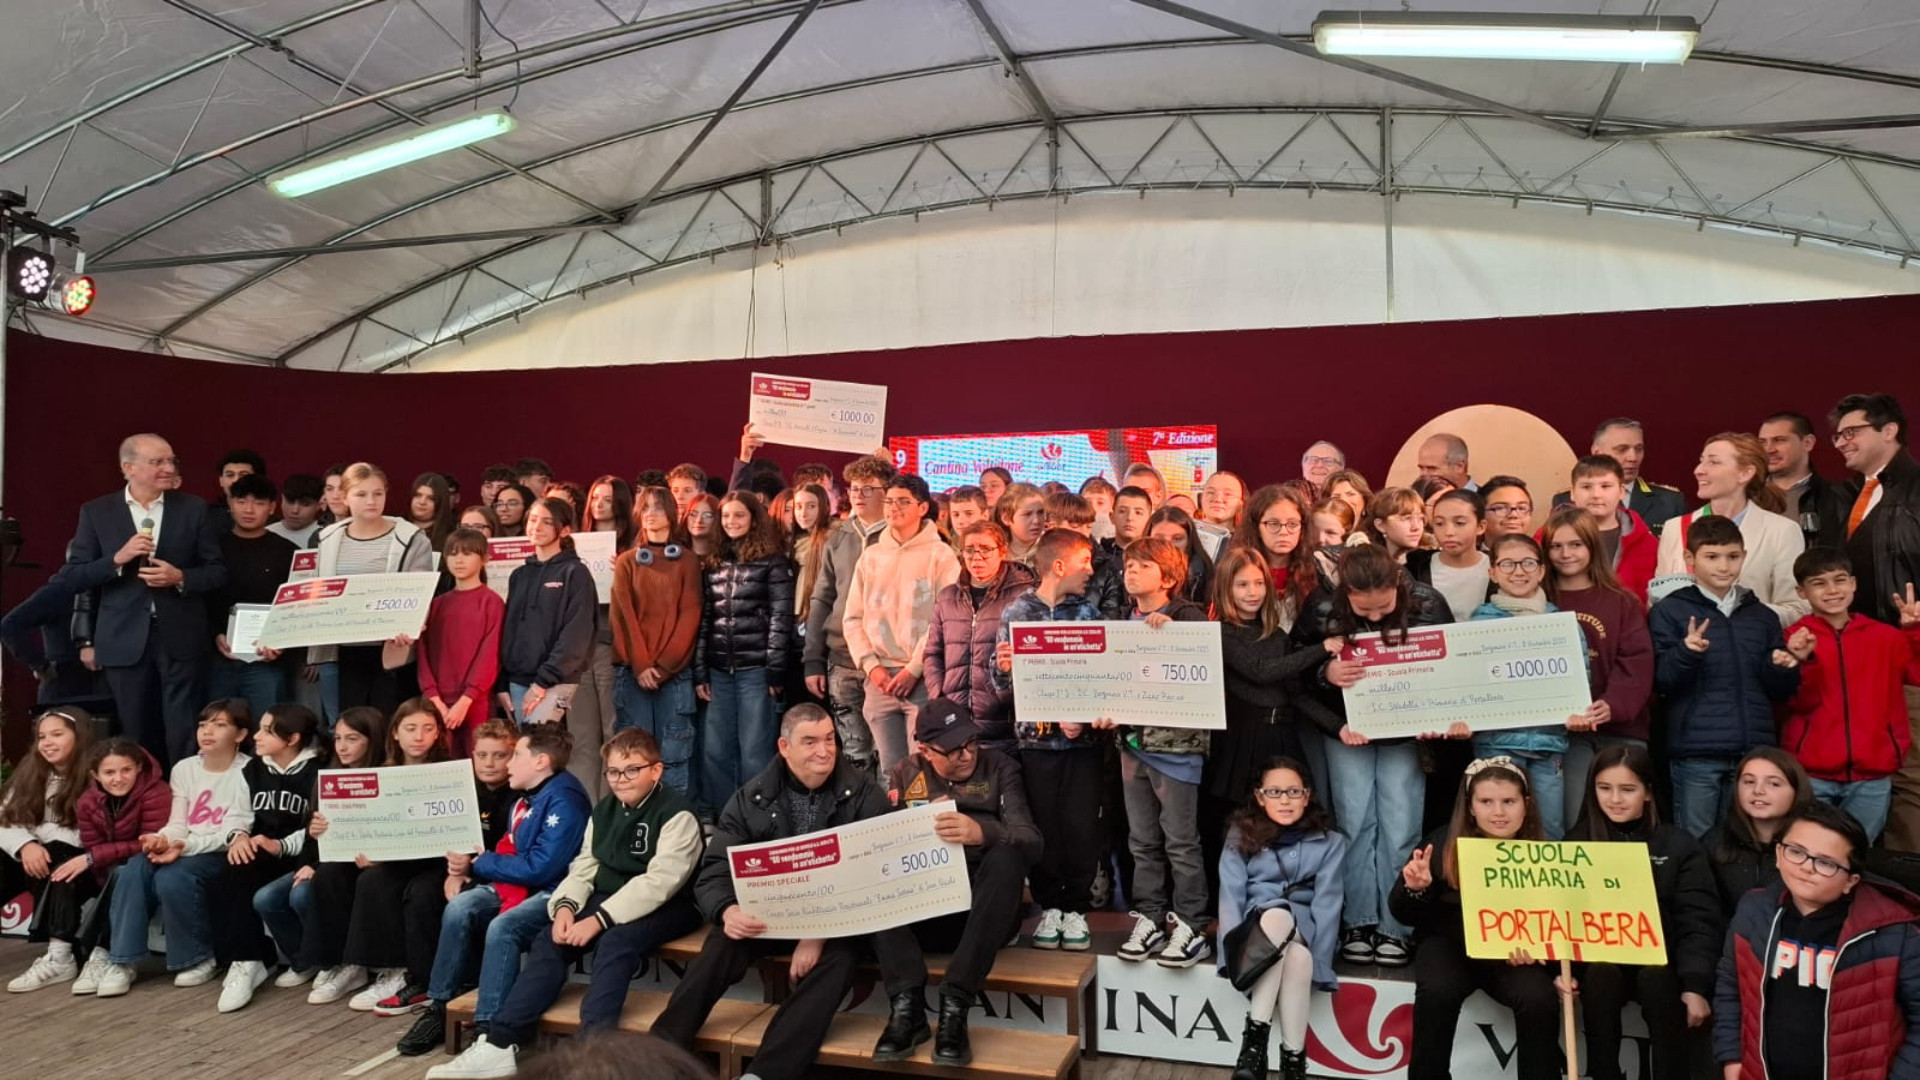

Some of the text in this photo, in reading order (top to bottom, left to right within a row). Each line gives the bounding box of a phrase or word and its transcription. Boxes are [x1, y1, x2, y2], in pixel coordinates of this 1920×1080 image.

[1168, 431, 1214, 445] Edizione
[925, 460, 968, 474] Cantina
[1142, 664, 1208, 681] € 750,00
[1491, 657, 1568, 679] € 1000,00
[882, 847, 949, 876] € 500,00
[1495, 841, 1593, 867] SCUOLA
[776, 875, 811, 887] SPECIALE
[1484, 867, 1621, 889] PRIMARIA DI
[1478, 908, 1659, 948] PORTALBERA
